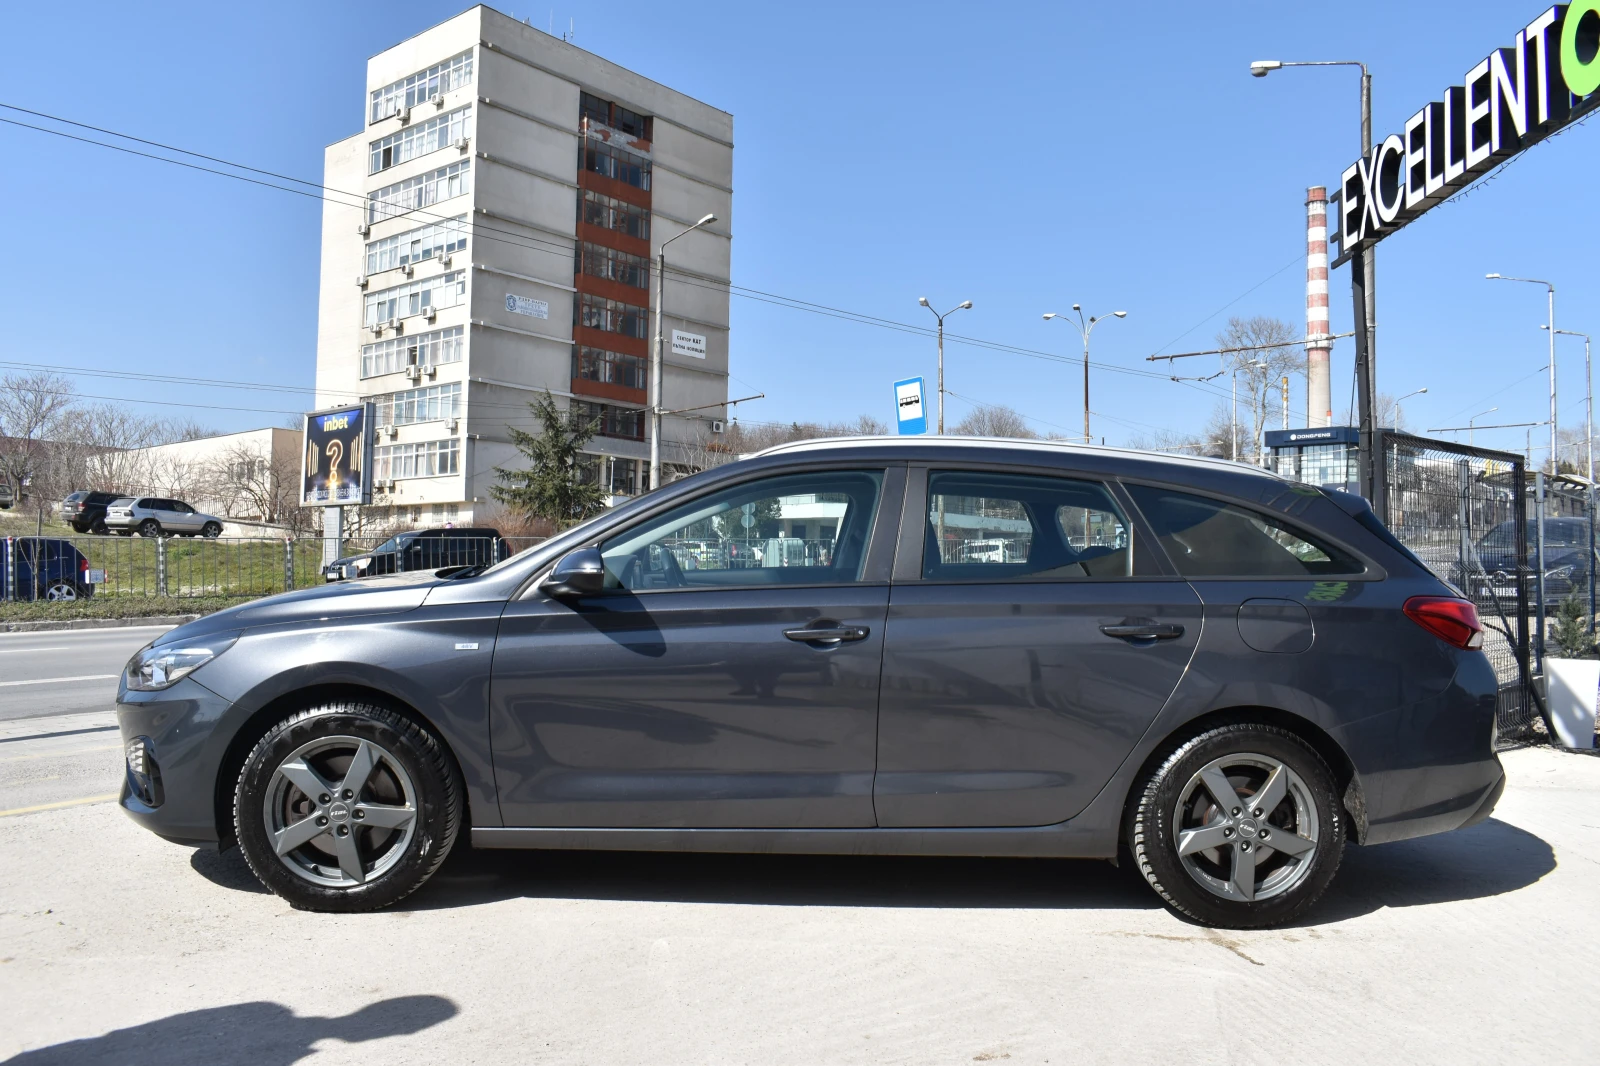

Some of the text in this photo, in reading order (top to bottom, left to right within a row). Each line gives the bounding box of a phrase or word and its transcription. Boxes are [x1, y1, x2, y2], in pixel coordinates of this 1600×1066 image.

[1341, 5, 1556, 250] EXCELLENT
[324, 415, 348, 432] inbet
[1296, 432, 1331, 440] DONGFENG
